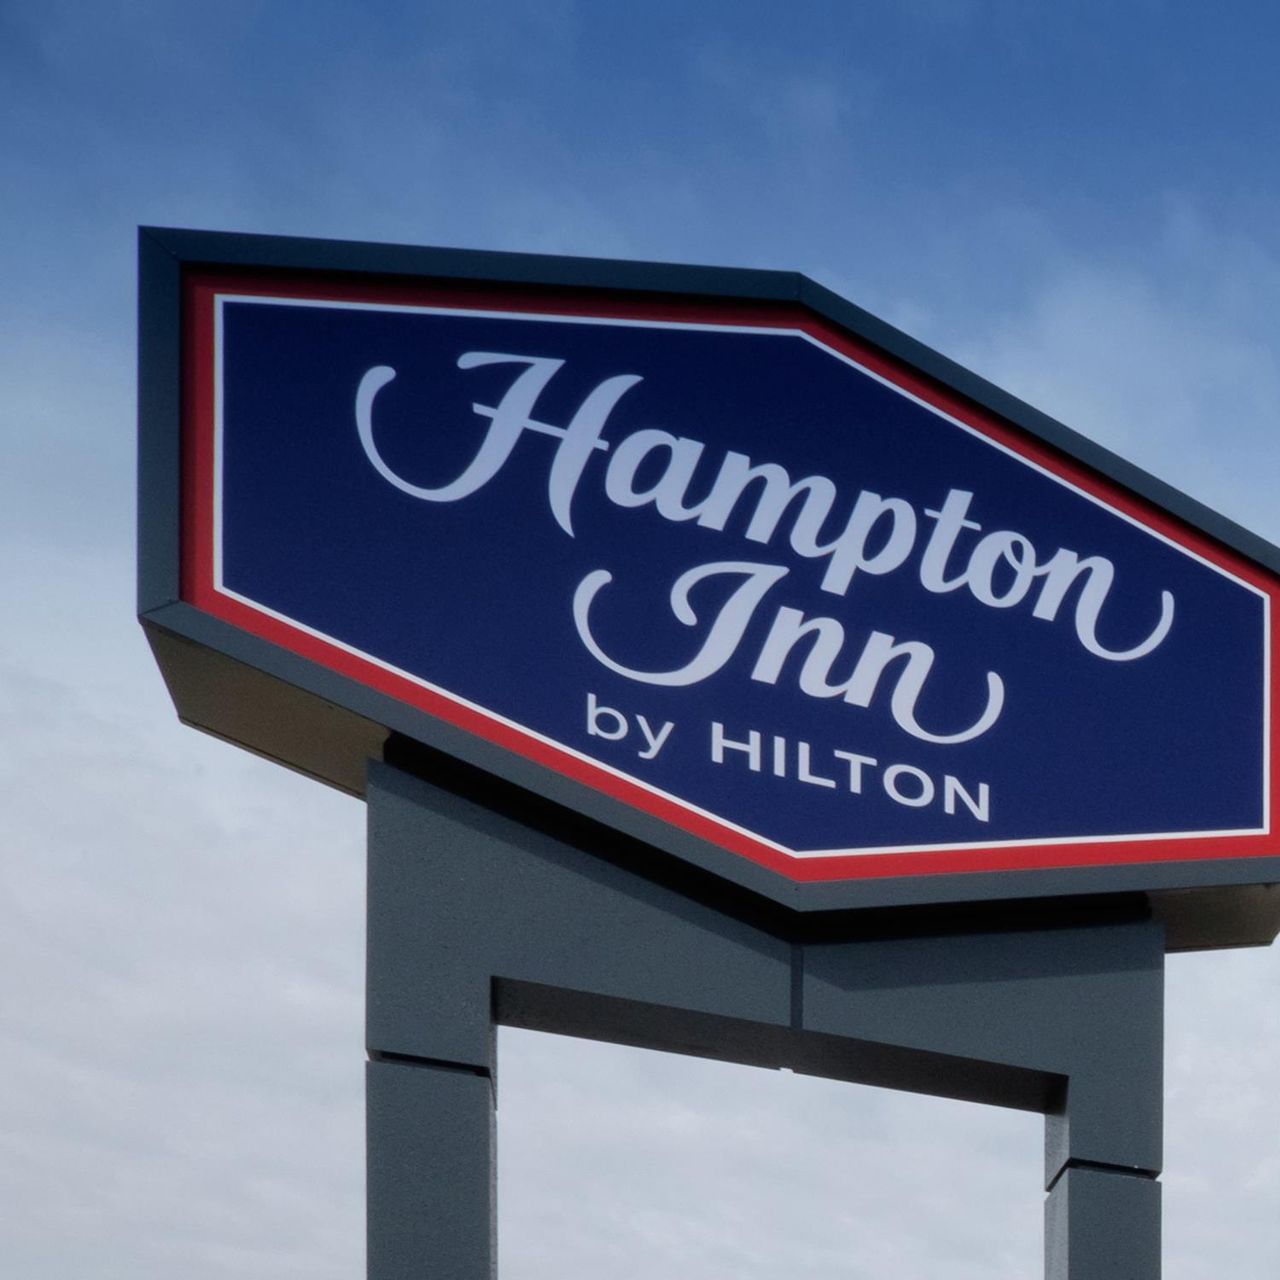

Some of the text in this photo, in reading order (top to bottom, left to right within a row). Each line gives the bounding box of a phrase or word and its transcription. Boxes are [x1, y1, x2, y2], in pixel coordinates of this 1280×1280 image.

[355, 352, 1175, 662] Hampton
[572, 561, 1005, 745] Inn
[587, 692, 990, 823] by HILTON
